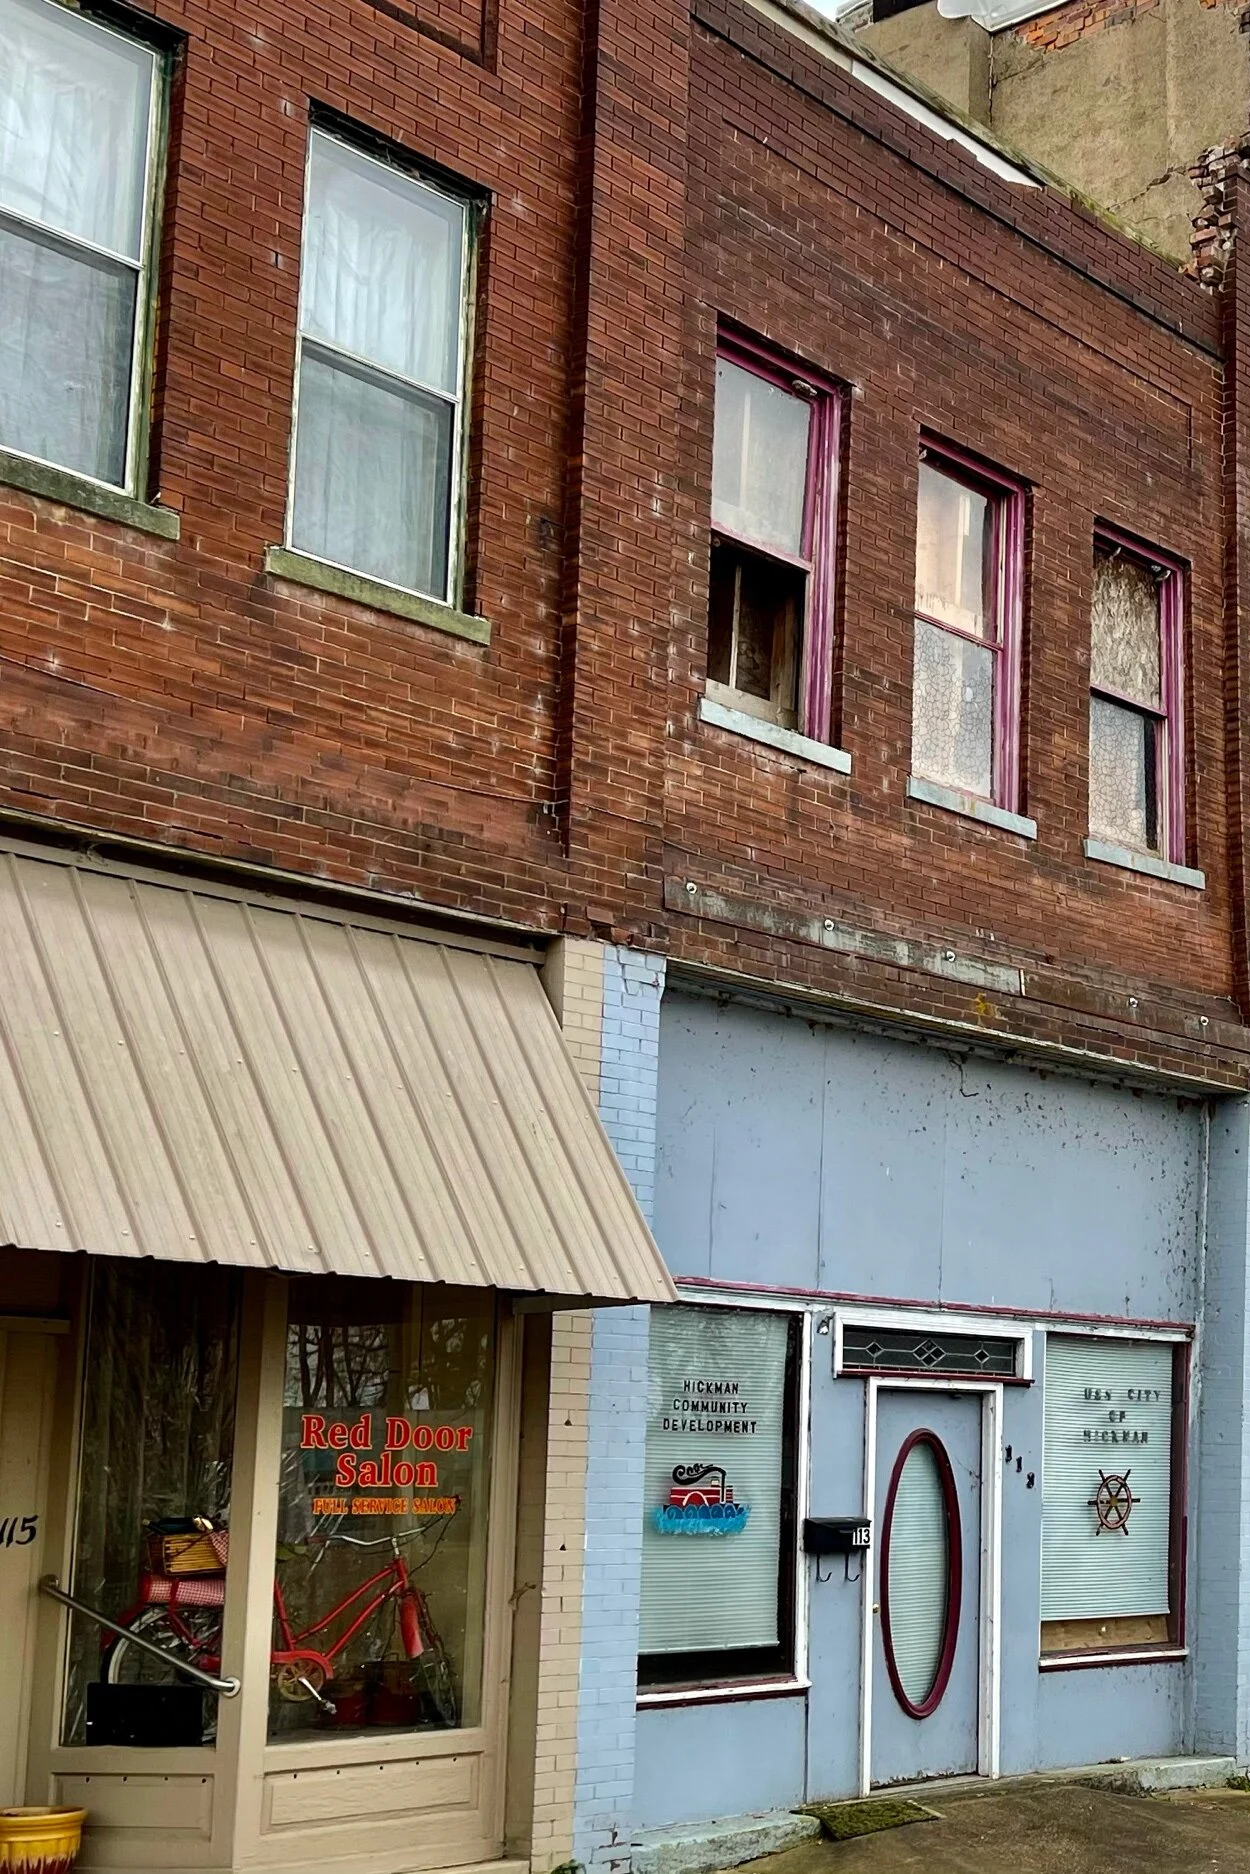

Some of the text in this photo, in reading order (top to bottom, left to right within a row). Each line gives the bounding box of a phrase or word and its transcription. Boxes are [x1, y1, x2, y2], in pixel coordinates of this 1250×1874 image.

[683, 1380, 739, 1394] HICKMAN
[1127, 1389, 1160, 1402] CITY
[673, 1399, 748, 1413] COMMUNITY
[1108, 1410, 1126, 1423] OF
[301, 1414, 474, 1451] Red Door
[663, 1418, 757, 1433] DEVELOPMENT
[1083, 1430, 1148, 1444] HICKMAN
[336, 1451, 438, 1487] Salon
[313, 1497, 457, 1515] FULL SERVICE SALON
[0, 1514, 39, 1548] 115
[853, 1528, 871, 1544] 113
